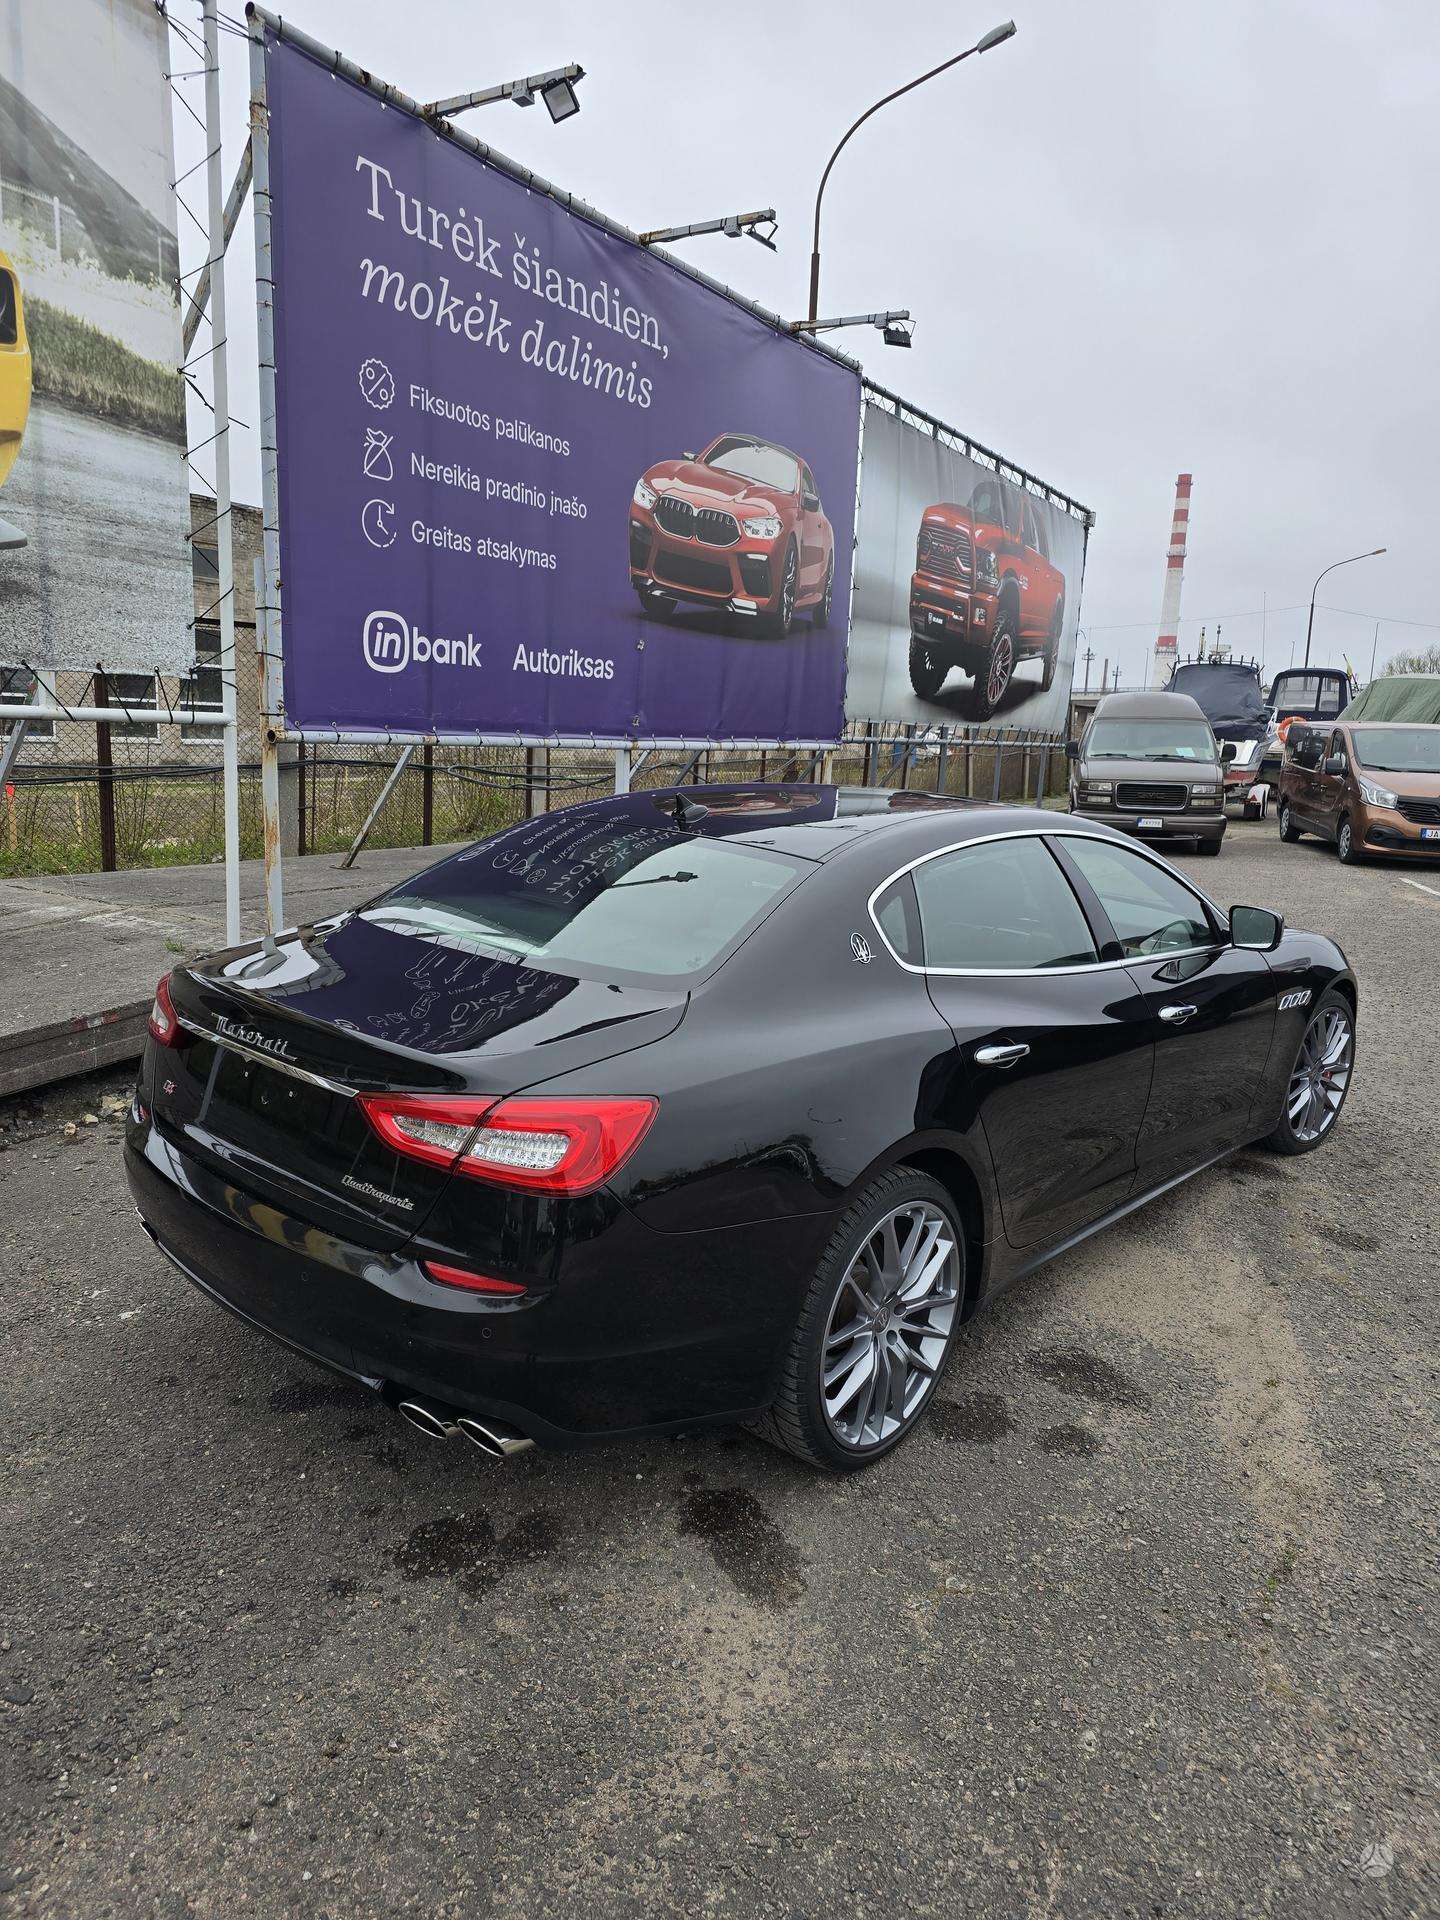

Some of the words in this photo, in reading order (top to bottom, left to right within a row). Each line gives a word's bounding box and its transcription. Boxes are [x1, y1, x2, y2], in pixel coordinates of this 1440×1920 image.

[355, 155, 503, 279] Turėk
[512, 231, 670, 360] šiandien,
[358, 258, 512, 354] mokėk
[520, 319, 653, 409] dalimis
[409, 384, 491, 431] Fiksuotos
[495, 416, 570, 456] palūkanos
[411, 452, 481, 493] Nereikia
[486, 478, 546, 509] pradinio
[550, 491, 588, 519] įnašo
[411, 520, 472, 553] Greitas
[477, 536, 557, 570] atsakymas
[363, 611, 482, 674] inbank
[512, 643, 614, 680] Autoriksas
[211, 1012, 298, 1061] Maserati
